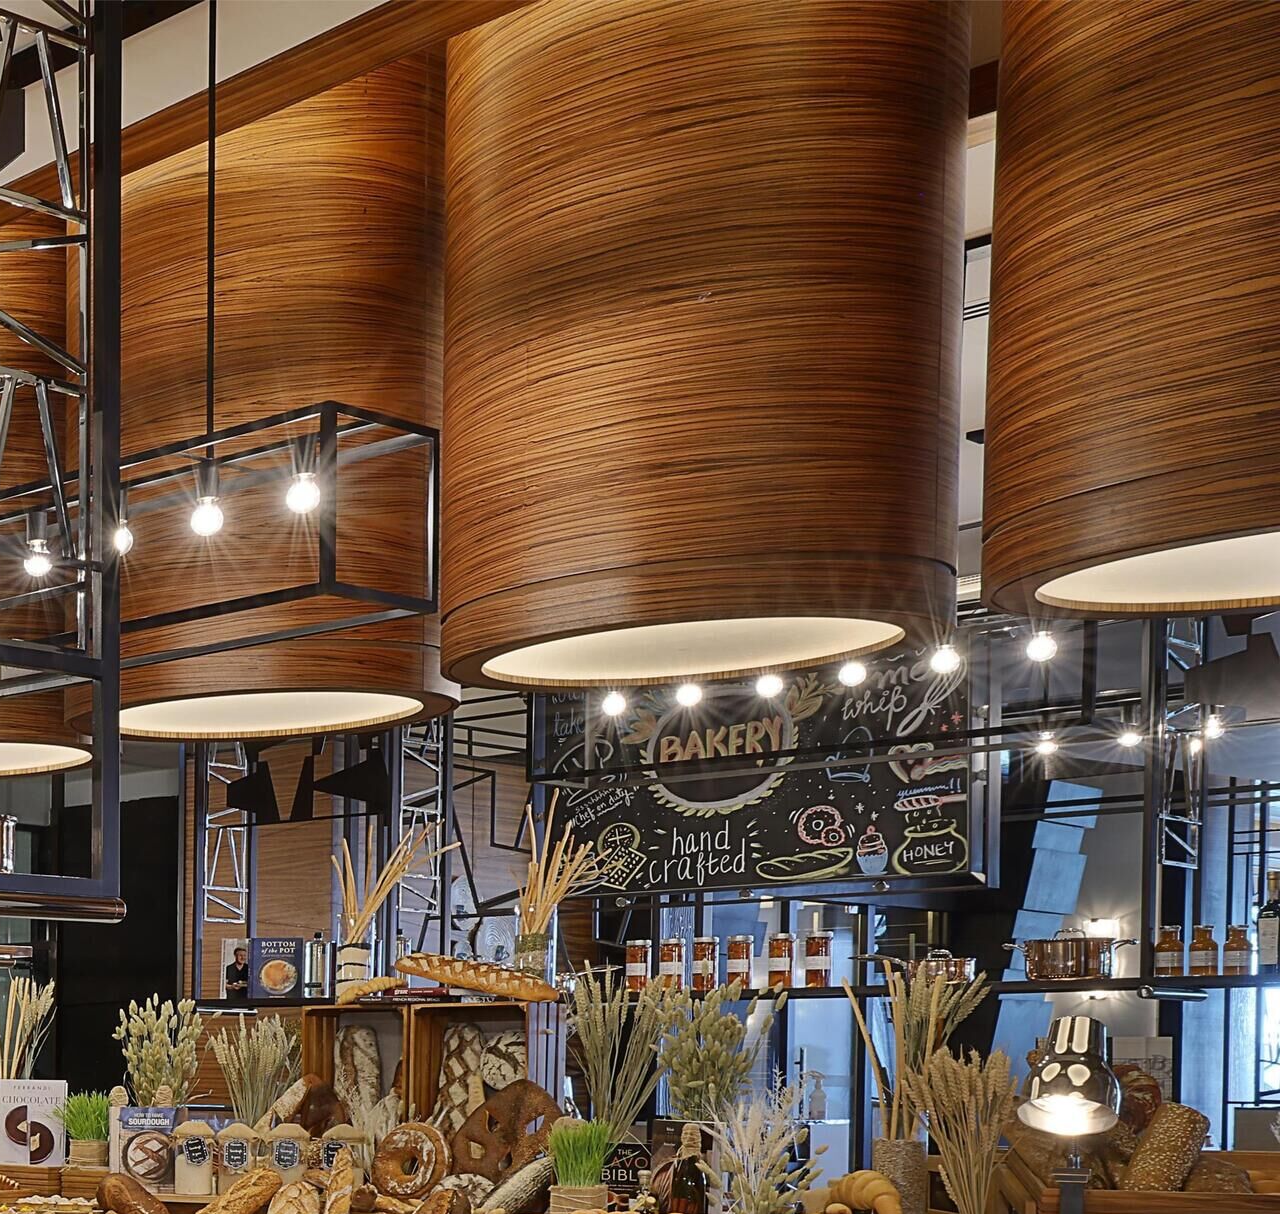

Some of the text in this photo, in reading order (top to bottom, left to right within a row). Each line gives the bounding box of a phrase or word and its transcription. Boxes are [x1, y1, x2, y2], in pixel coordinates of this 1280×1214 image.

[659, 715, 783, 767] BAKERY
[671, 819, 731, 856] hand
[649, 837, 745, 886] crafted
[902, 840, 955, 862] HONEY
[2, 1096, 61, 1105] CHOCOLATE
[128, 1118, 170, 1126] SOURDOUGH
[601, 1168, 638, 1182] BIBL
